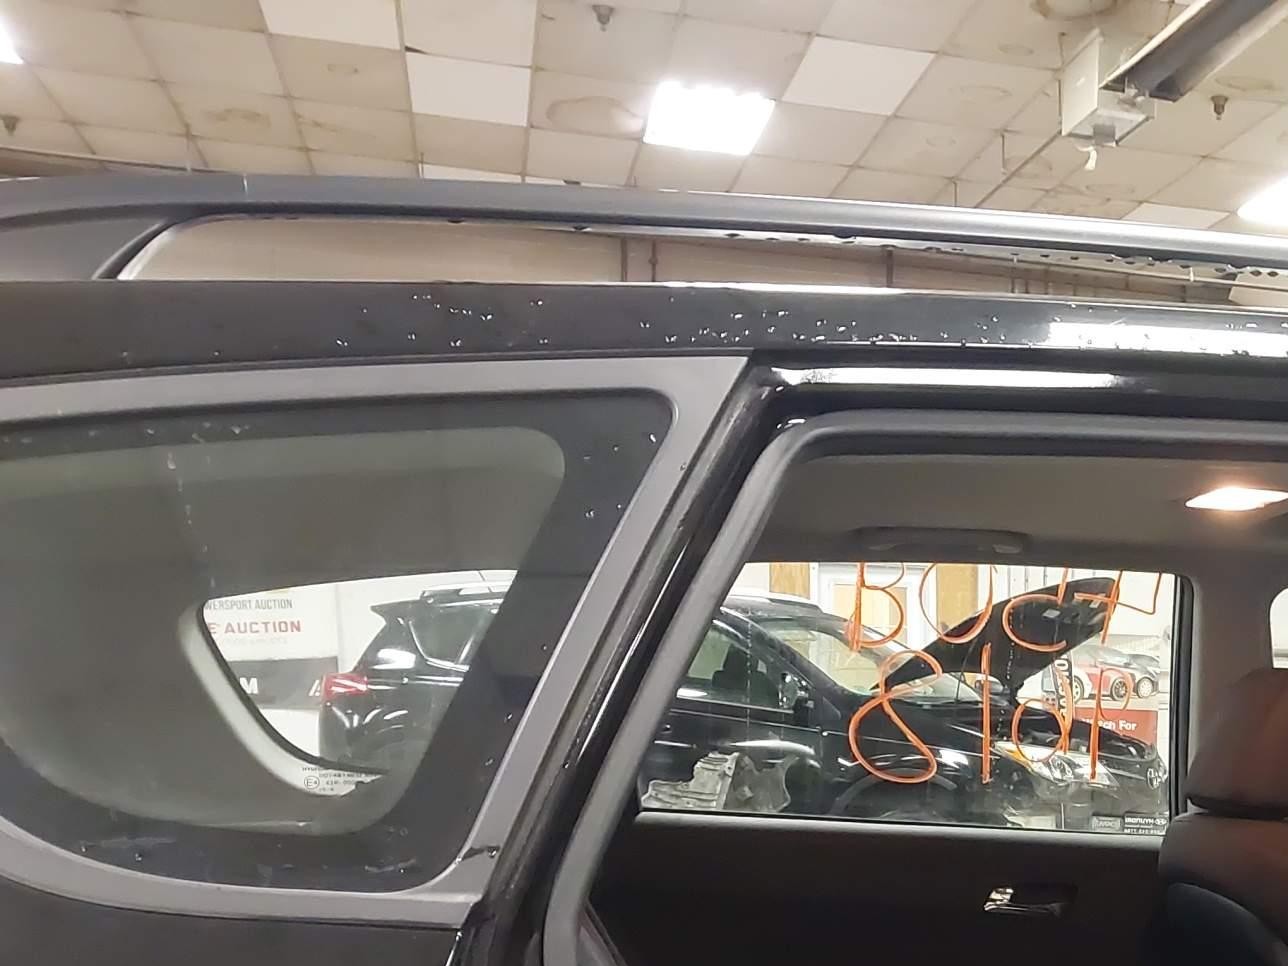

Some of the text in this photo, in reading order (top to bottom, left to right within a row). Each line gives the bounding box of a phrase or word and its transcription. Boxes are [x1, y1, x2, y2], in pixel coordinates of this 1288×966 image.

[255, 599, 294, 610] AUCTION
[224, 620, 302, 634] AUCTION
[1119, 720, 1138, 731] For
